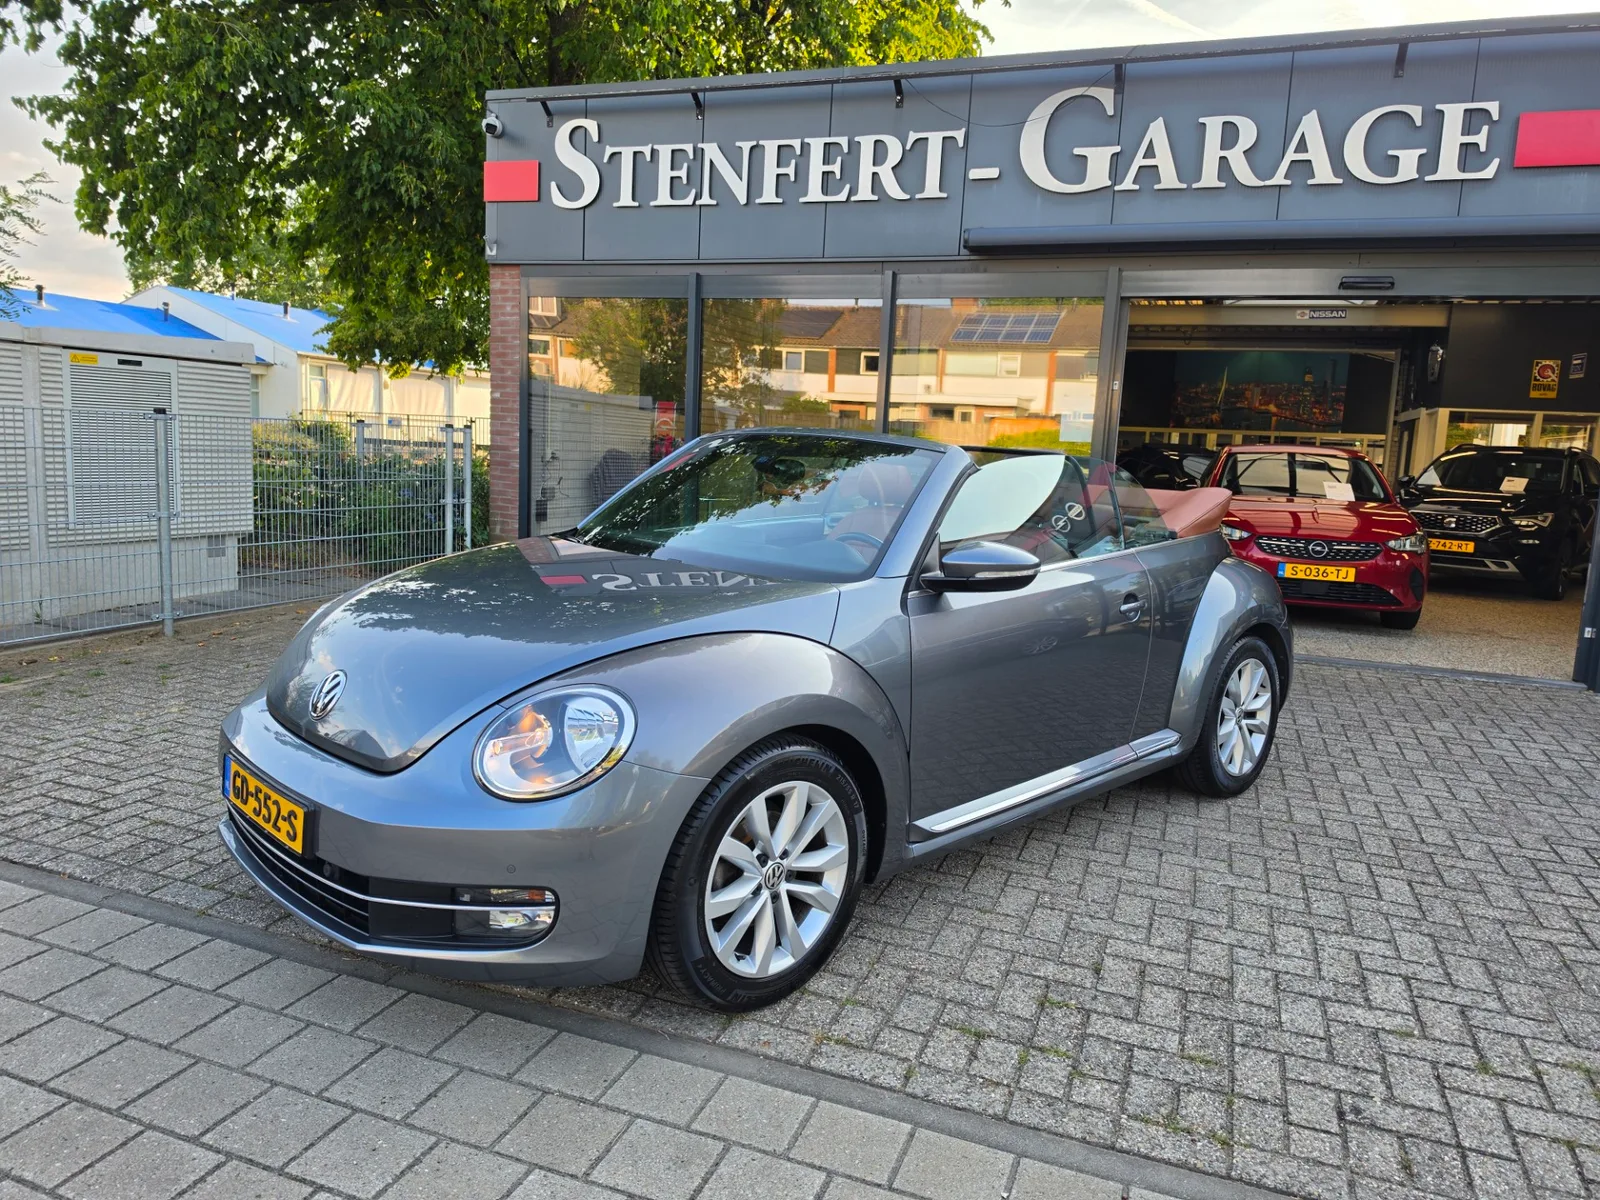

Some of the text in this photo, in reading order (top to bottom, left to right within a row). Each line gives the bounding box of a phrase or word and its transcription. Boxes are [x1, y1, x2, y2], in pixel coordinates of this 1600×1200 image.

[1019, 86, 1501, 194] GARAGE
[1310, 310, 1346, 318] NISSAN
[1290, 565, 1349, 580] S-036-TJ
[232, 769, 298, 842] GD-552-S
